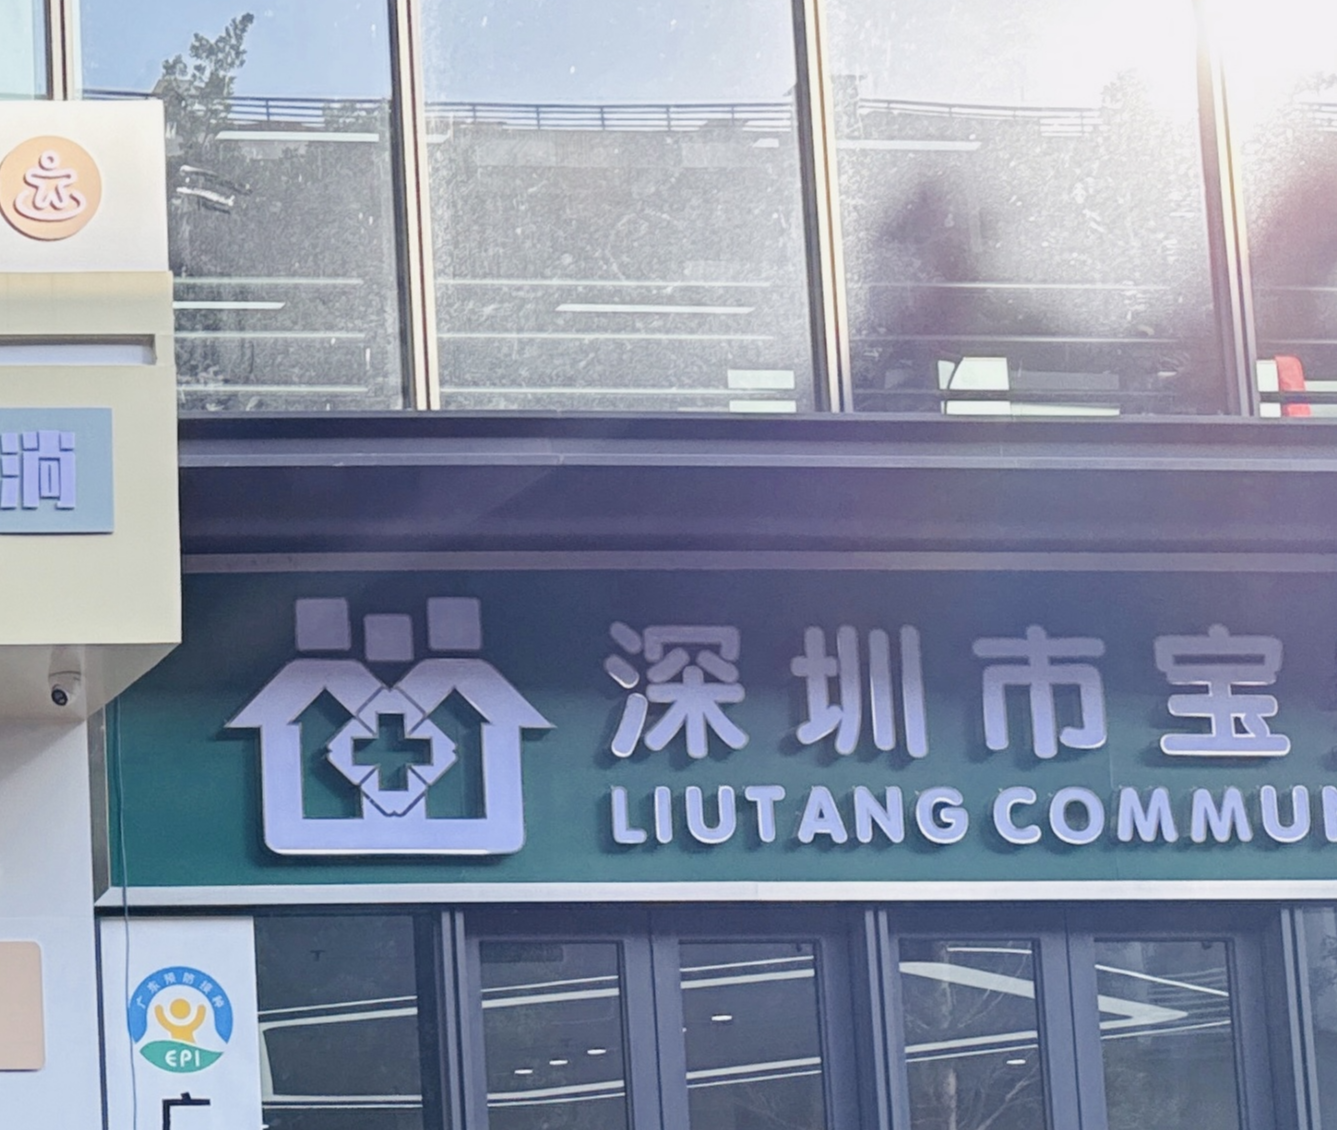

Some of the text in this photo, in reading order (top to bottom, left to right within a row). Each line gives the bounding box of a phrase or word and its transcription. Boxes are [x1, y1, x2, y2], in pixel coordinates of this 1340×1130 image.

[604, 620, 1291, 758] 深圳市宝
[610, 784, 970, 845] LIUTANG
[164, 1049, 201, 1068] EPI
